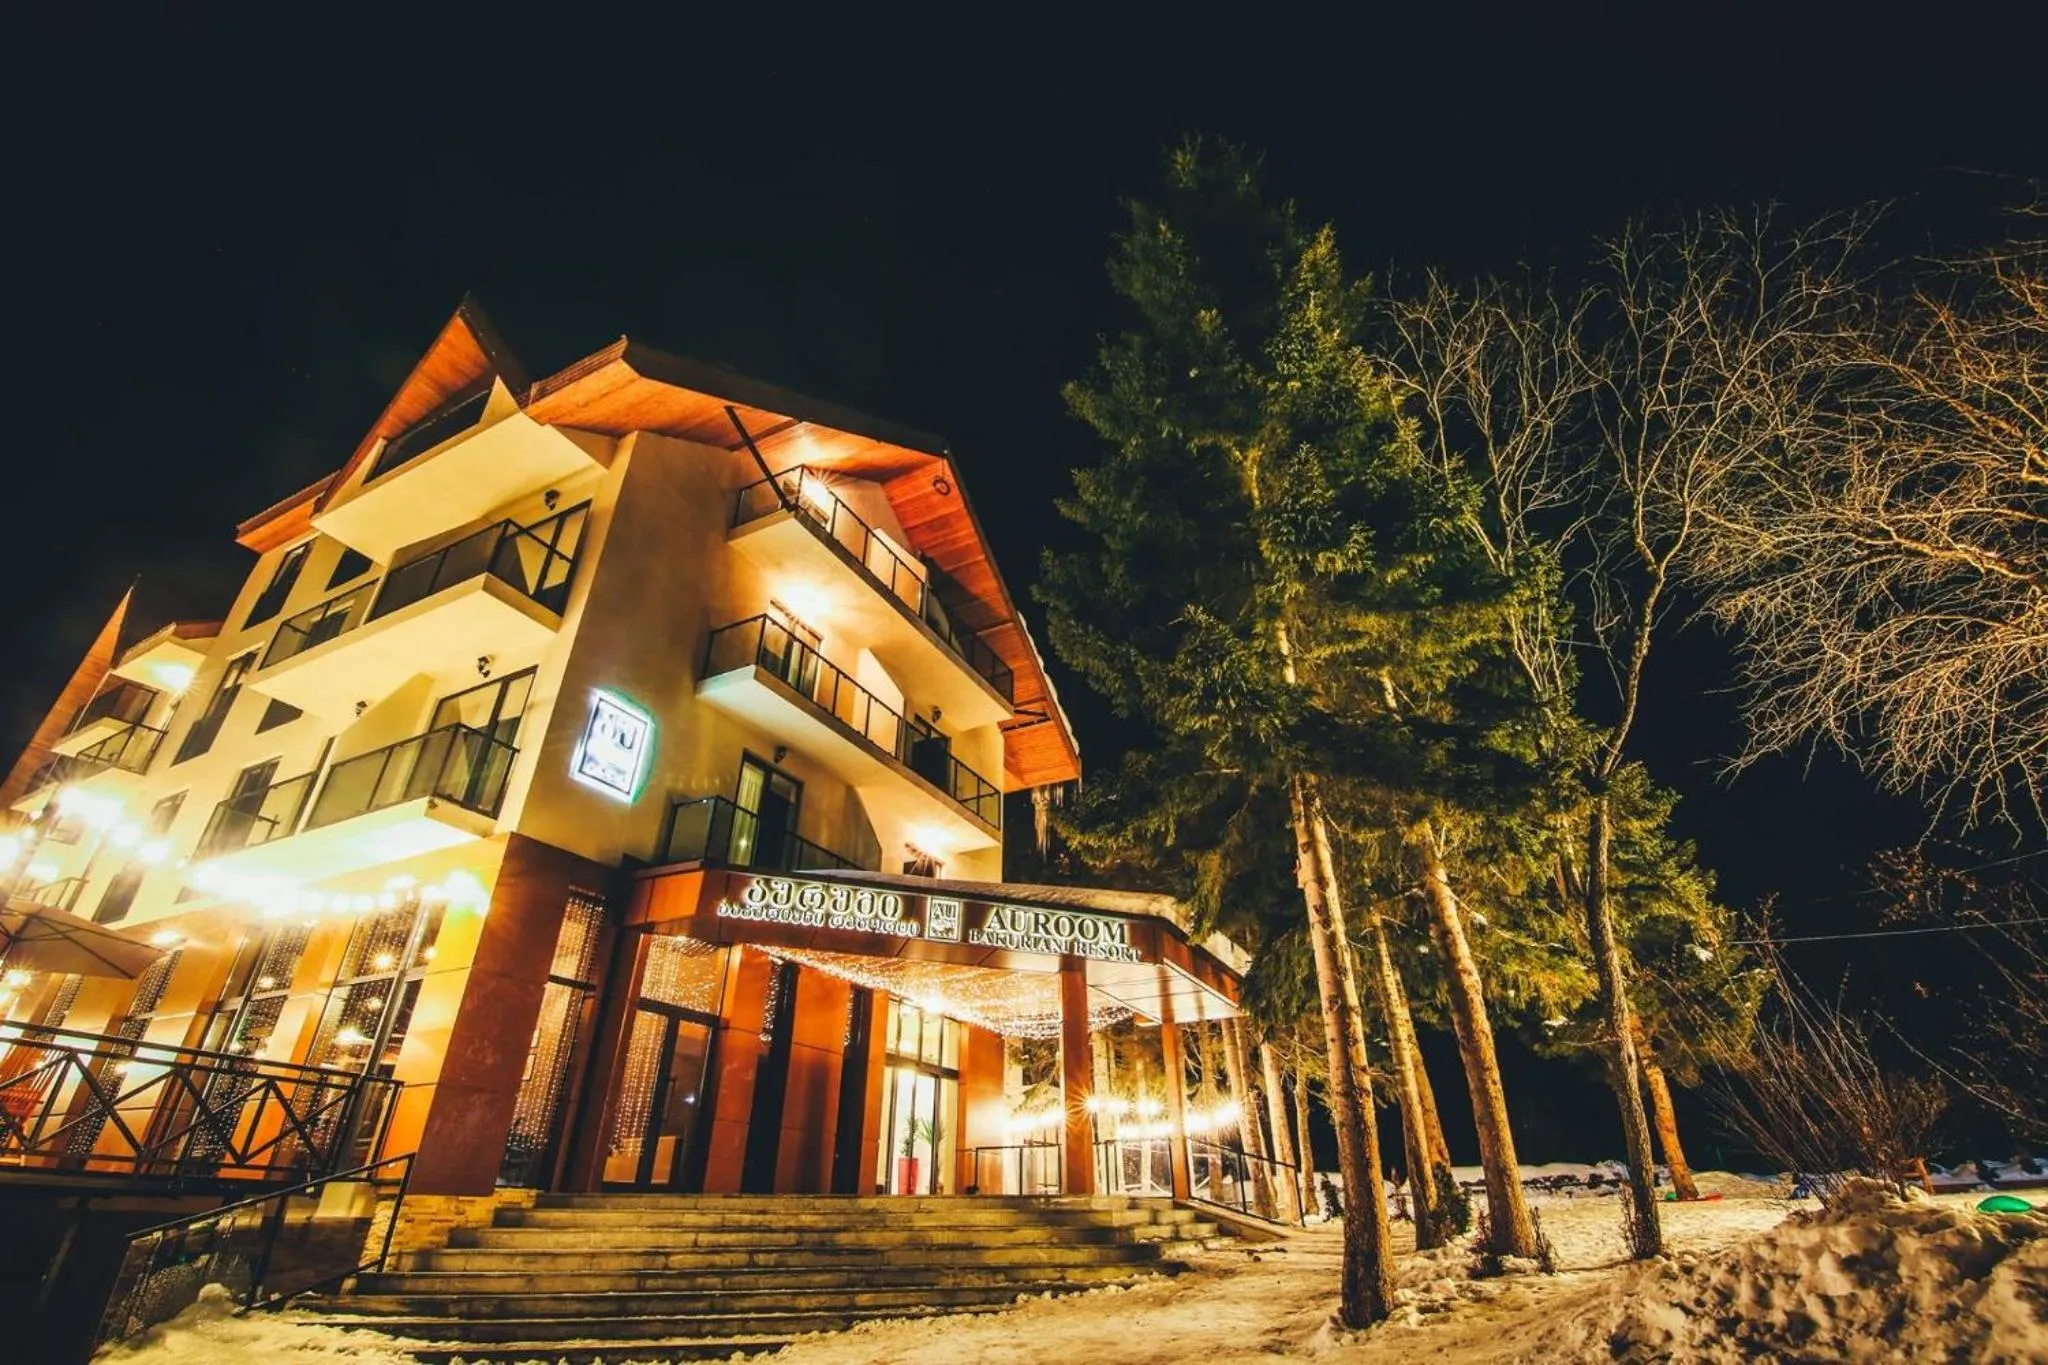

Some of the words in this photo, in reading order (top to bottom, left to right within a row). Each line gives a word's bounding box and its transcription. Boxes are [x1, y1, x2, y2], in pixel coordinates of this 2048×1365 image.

[747, 878, 901, 921] აურუმი
[985, 906, 1128, 945] AUROOM
[969, 929, 1070, 955] BAKURIANI
[1074, 940, 1142, 963] RESORT
